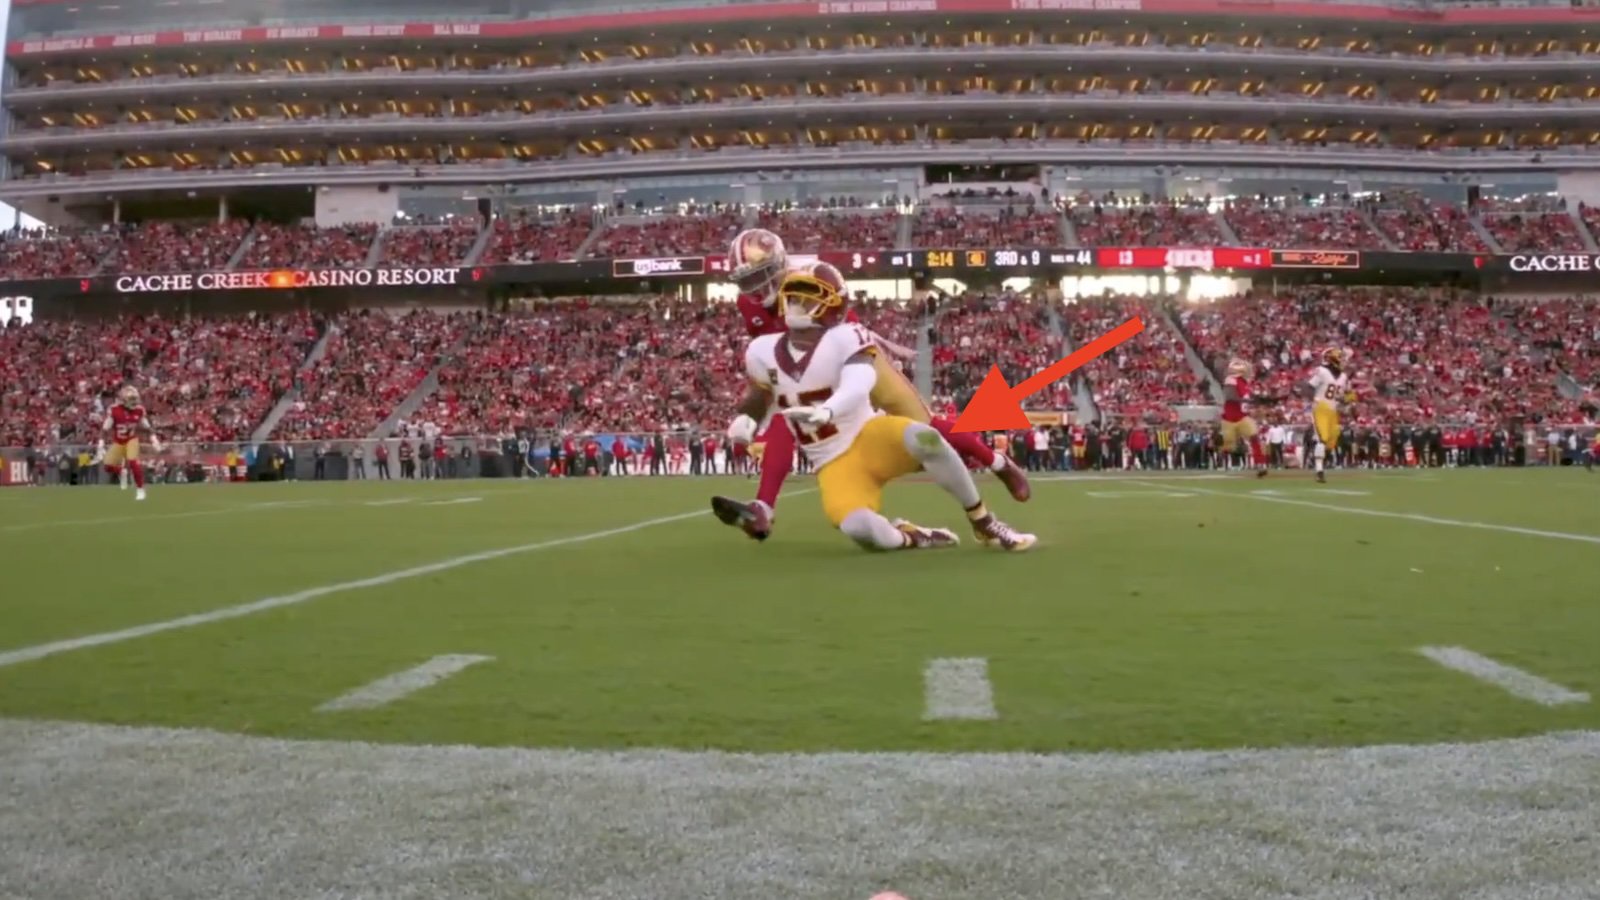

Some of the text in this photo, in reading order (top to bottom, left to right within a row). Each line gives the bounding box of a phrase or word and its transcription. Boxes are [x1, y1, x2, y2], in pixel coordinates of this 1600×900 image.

[927, 252, 954, 267] 2:14
[995, 251, 1018, 266] 3RD
[1032, 251, 1040, 265] 9
[1077, 251, 1091, 265] 44
[1509, 255, 1591, 271] CACHE
[116, 268, 460, 292] CACHE CREEK CASINO RESORT
